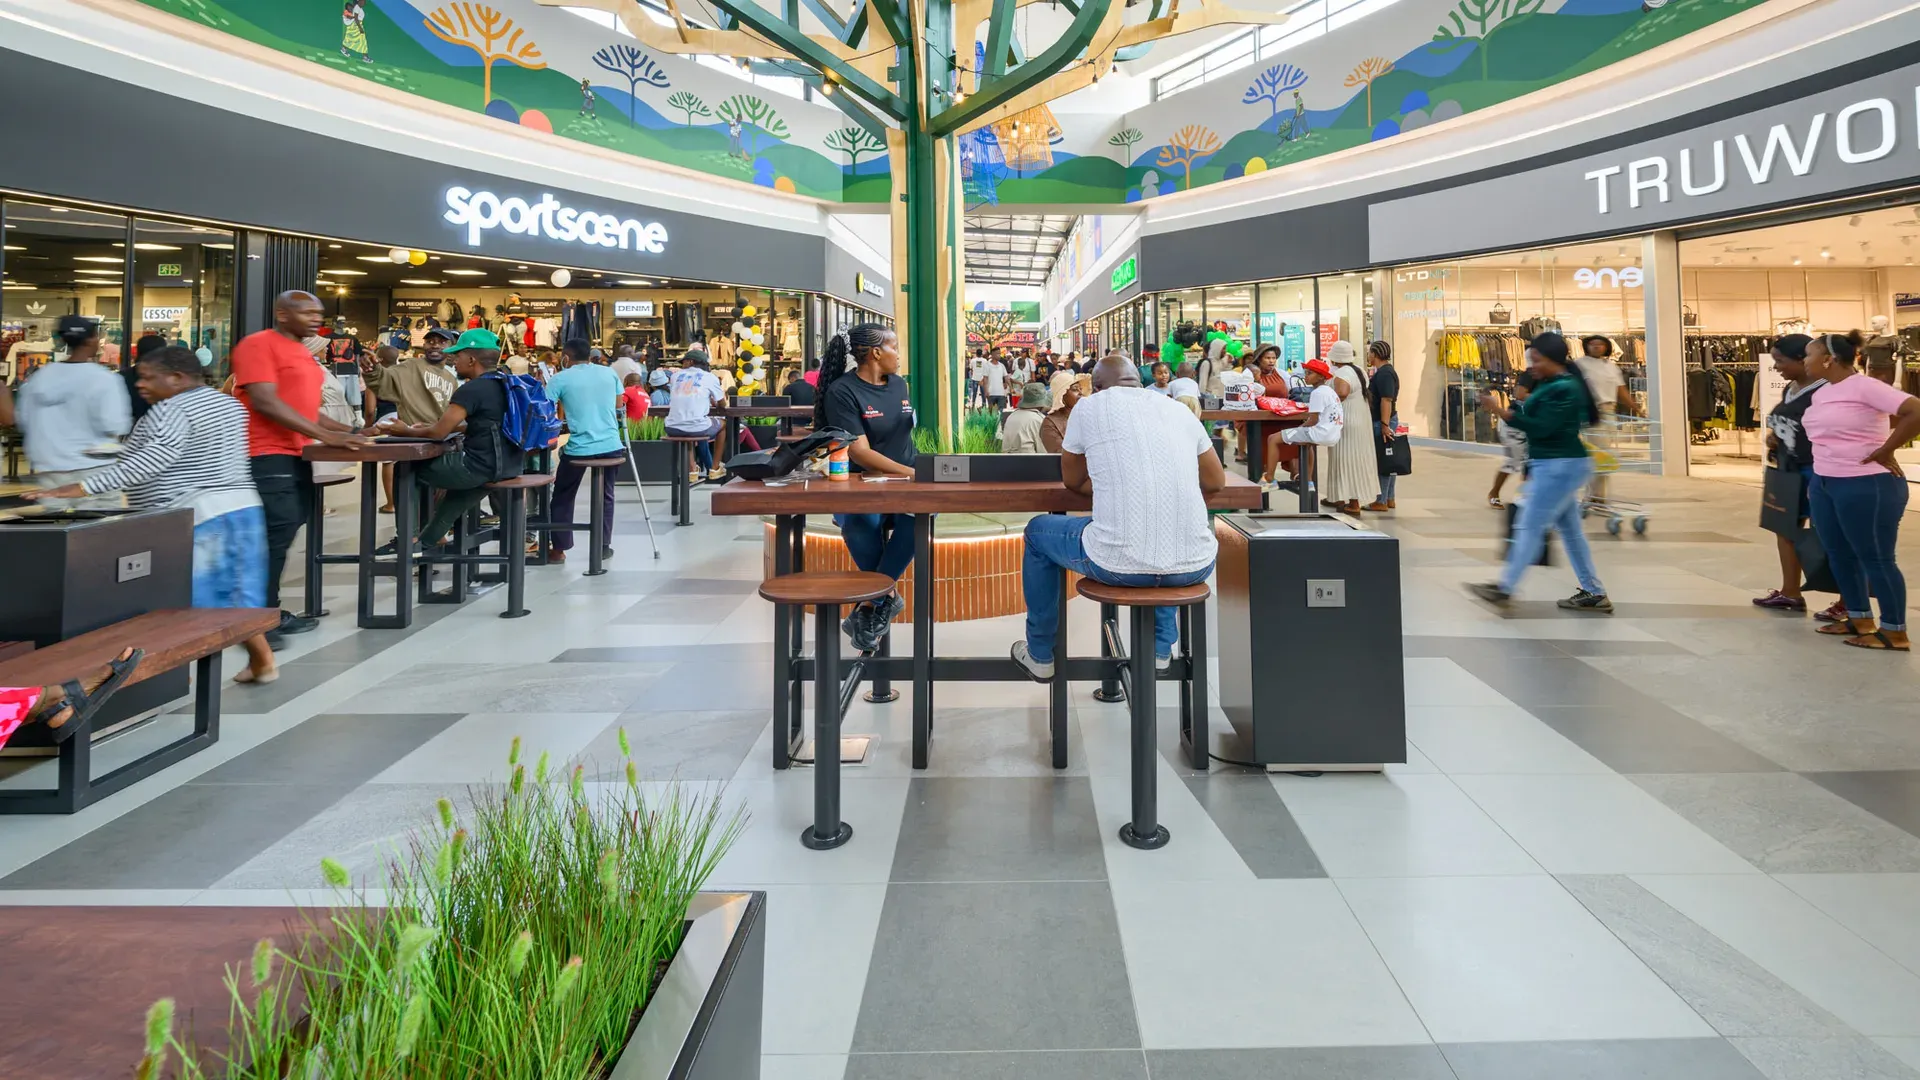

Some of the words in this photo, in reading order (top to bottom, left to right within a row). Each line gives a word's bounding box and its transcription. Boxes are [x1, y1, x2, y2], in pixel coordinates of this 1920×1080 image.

[1585, 86, 1920, 214] TRUWO
[443, 186, 669, 254] sportscene
[424, 370, 453, 401] CHICAGO
